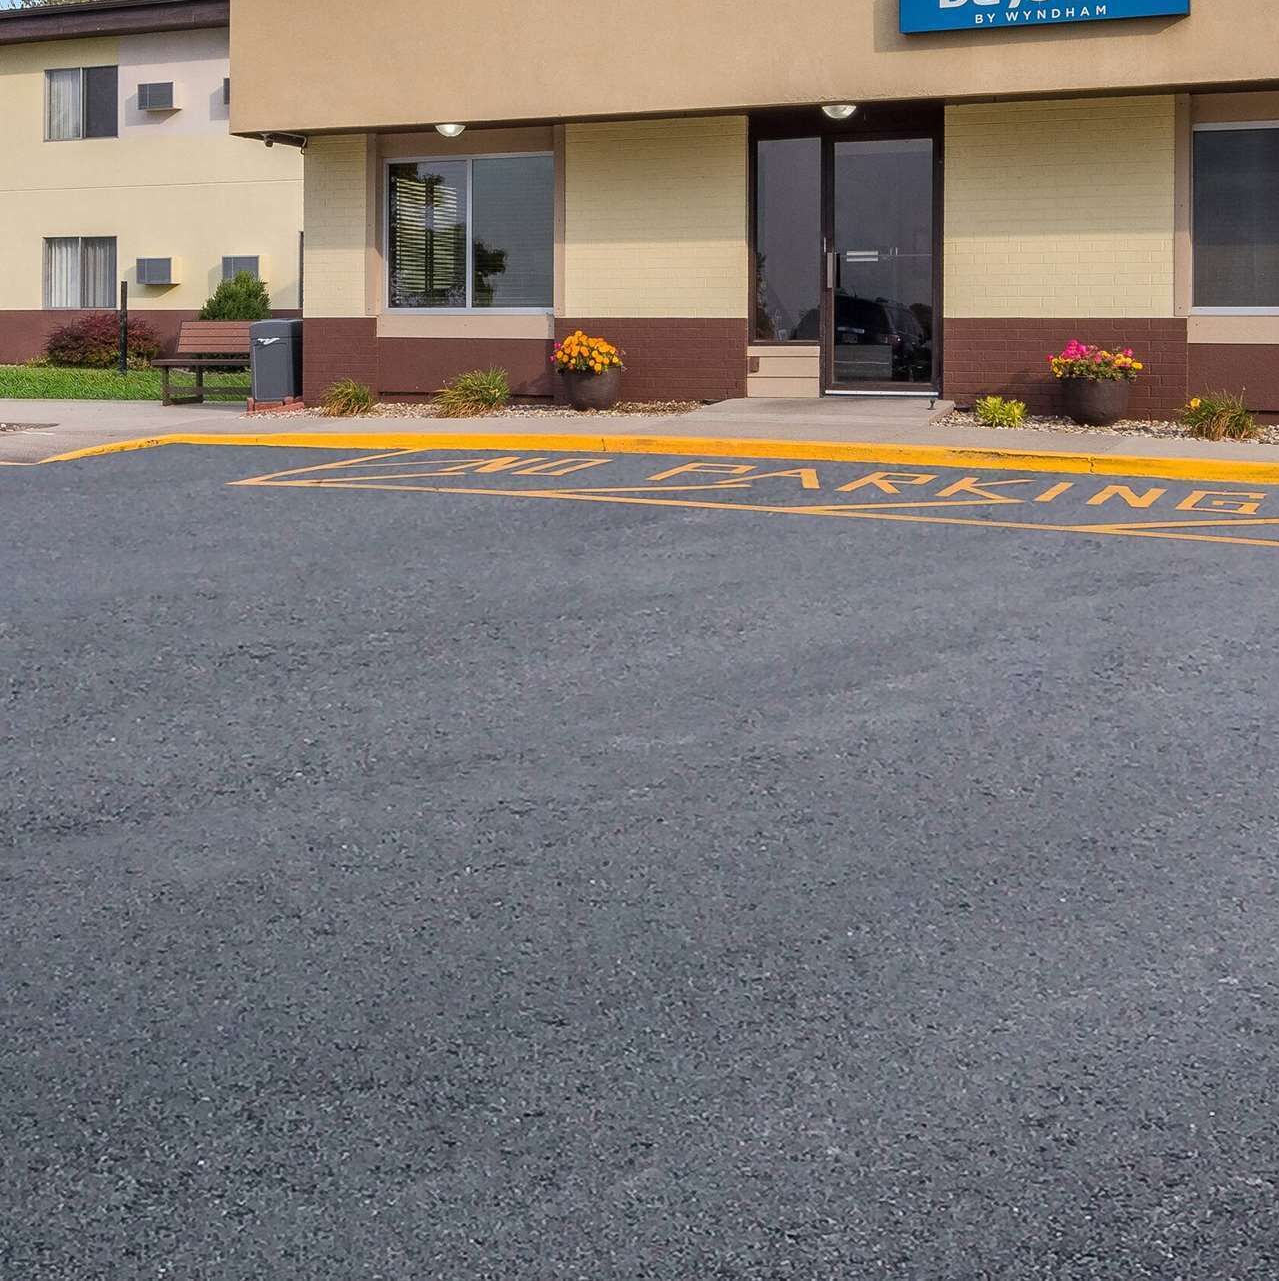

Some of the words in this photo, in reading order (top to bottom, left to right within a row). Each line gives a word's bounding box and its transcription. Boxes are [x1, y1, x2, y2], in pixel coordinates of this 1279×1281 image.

[974, 13, 996, 24] BY
[1005, 5, 1107, 22] WYNDHAM
[439, 456, 614, 476] NO
[645, 462, 1269, 515] PARKING
